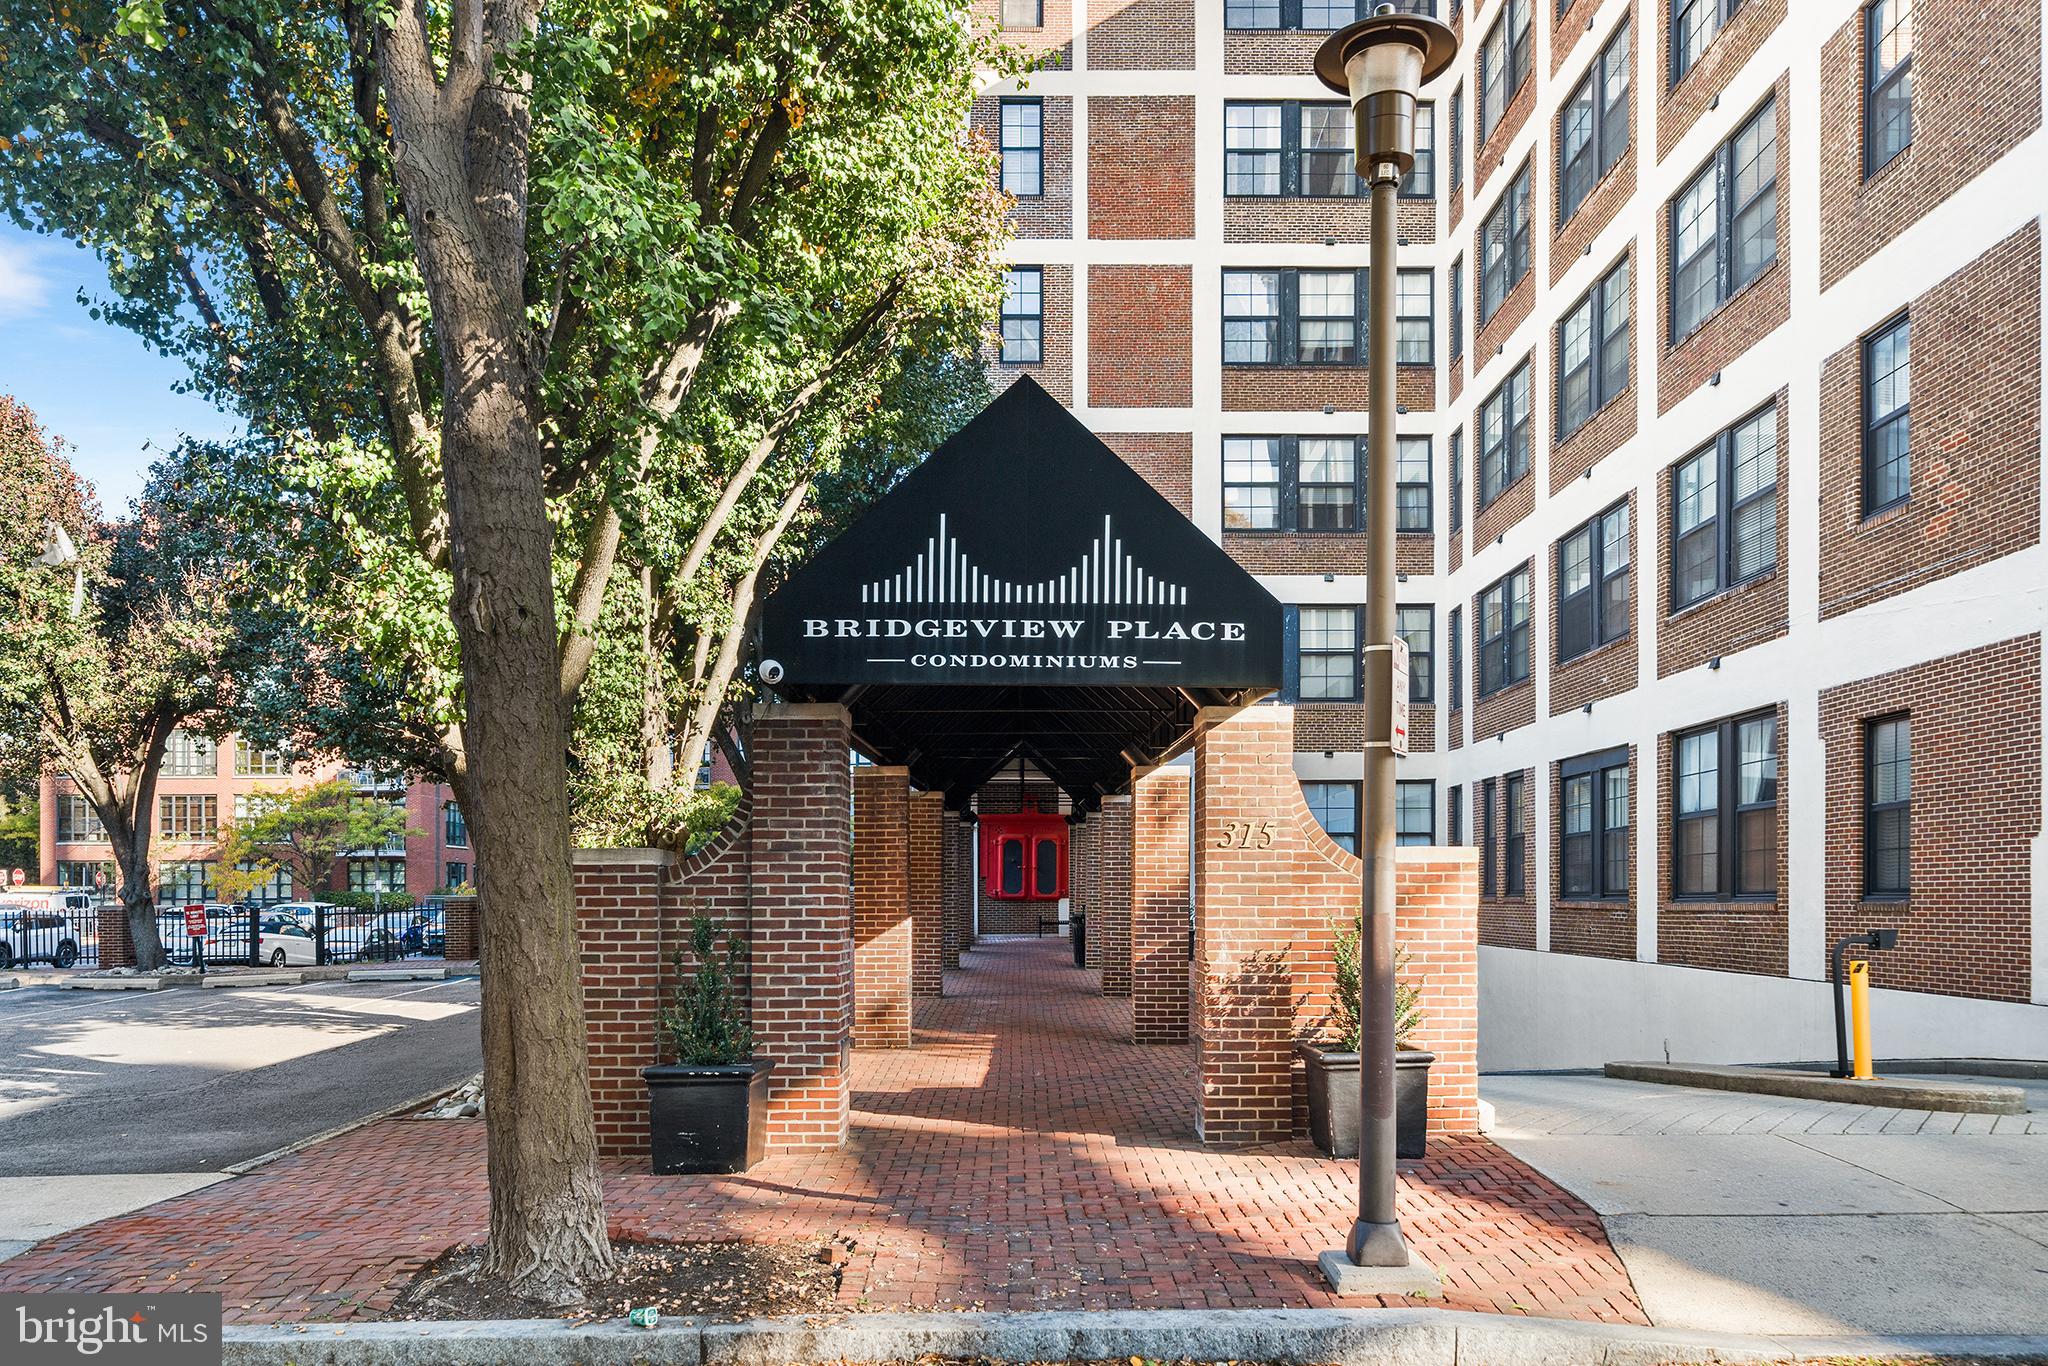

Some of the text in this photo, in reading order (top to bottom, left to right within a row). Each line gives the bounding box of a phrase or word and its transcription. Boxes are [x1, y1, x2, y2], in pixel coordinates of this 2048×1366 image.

[803, 620, 1245, 641] BRIDGEVIEW PLACE
[911, 655, 1137, 668] CONDOMINIUMS
[1216, 821, 1277, 850] 315
